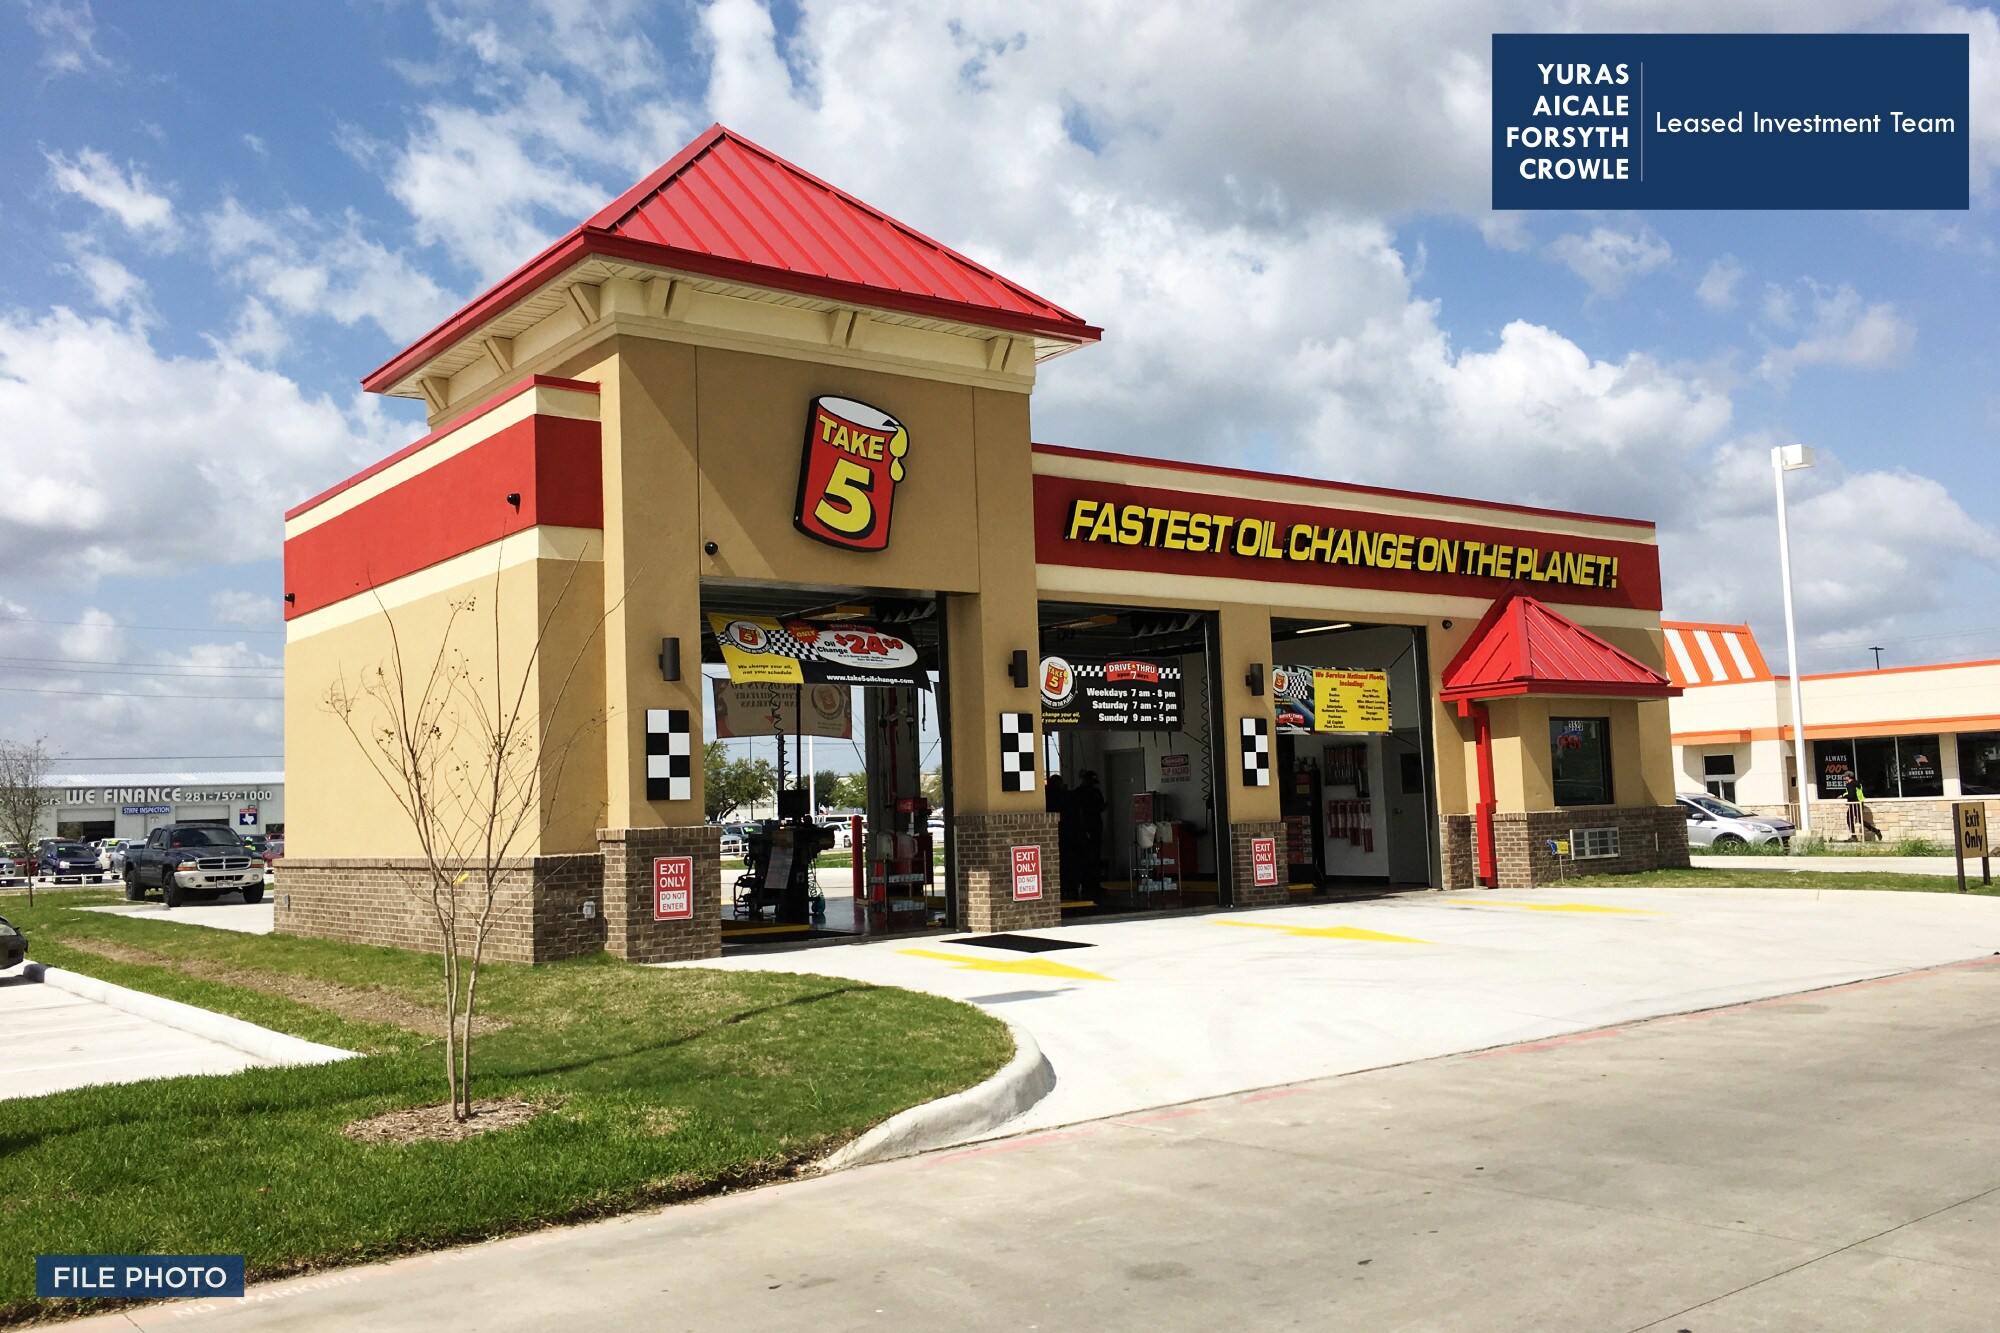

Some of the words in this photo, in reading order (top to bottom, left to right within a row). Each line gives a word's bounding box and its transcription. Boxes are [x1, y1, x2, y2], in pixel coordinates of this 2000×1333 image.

[819, 414, 886, 462] TAKE
[814, 457, 875, 534] 5
[1069, 499, 1234, 554] FASTEST
[1235, 518, 1283, 560] OIL
[1289, 524, 1416, 571] CHANGE
[1416, 536, 1460, 574] ON
[1463, 541, 1514, 579] THE
[1515, 546, 1619, 589] PLANET!
[817, 646, 848, 655] Change
[1048, 666, 1063, 677] TAKE
[1108, 663, 1131, 673] DRIVE
[1136, 663, 1155, 673] THRU
[826, 674, 915, 685] www.take5oilchange.com
[1130, 671, 1137, 679] 7
[1049, 676, 1059, 687] 5
[1339, 680, 1365, 688] Including:
[1086, 687, 1128, 698] Weekdays
[1157, 689, 1163, 697] 8
[1092, 700, 1129, 711] Saturday
[1158, 702, 1164, 710] 7
[1165, 703, 1177, 711] pm
[1098, 713, 1129, 723] Sunday
[1132, 714, 1138, 722] 9
[1158, 714, 1164, 722] 5
[1825, 763, 1848, 774] 100%
[65, 789, 95, 805] WE
[103, 787, 181, 804] FINANCE
[184, 790, 272, 802] 281-759-1000
[123, 806, 139, 814] STATE
[139, 806, 170, 814] INSPECTION
[1964, 808, 1979, 827] Exit
[1965, 829, 1983, 851] Only
[1255, 843, 1271, 852] EXIT
[1016, 851, 1035, 861] EXIT
[1255, 853, 1272, 862] ONLY
[660, 863, 686, 875] EXIT
[1016, 862, 1036, 873] ONLY
[660, 876, 686, 888] ONLY
[661, 893, 671, 901] DO
[672, 892, 685, 900] NOT
[662, 902, 684, 911] ENTER
[172, 1303, 218, 1318] NO
[235, 1274, 362, 1305] PARKING
